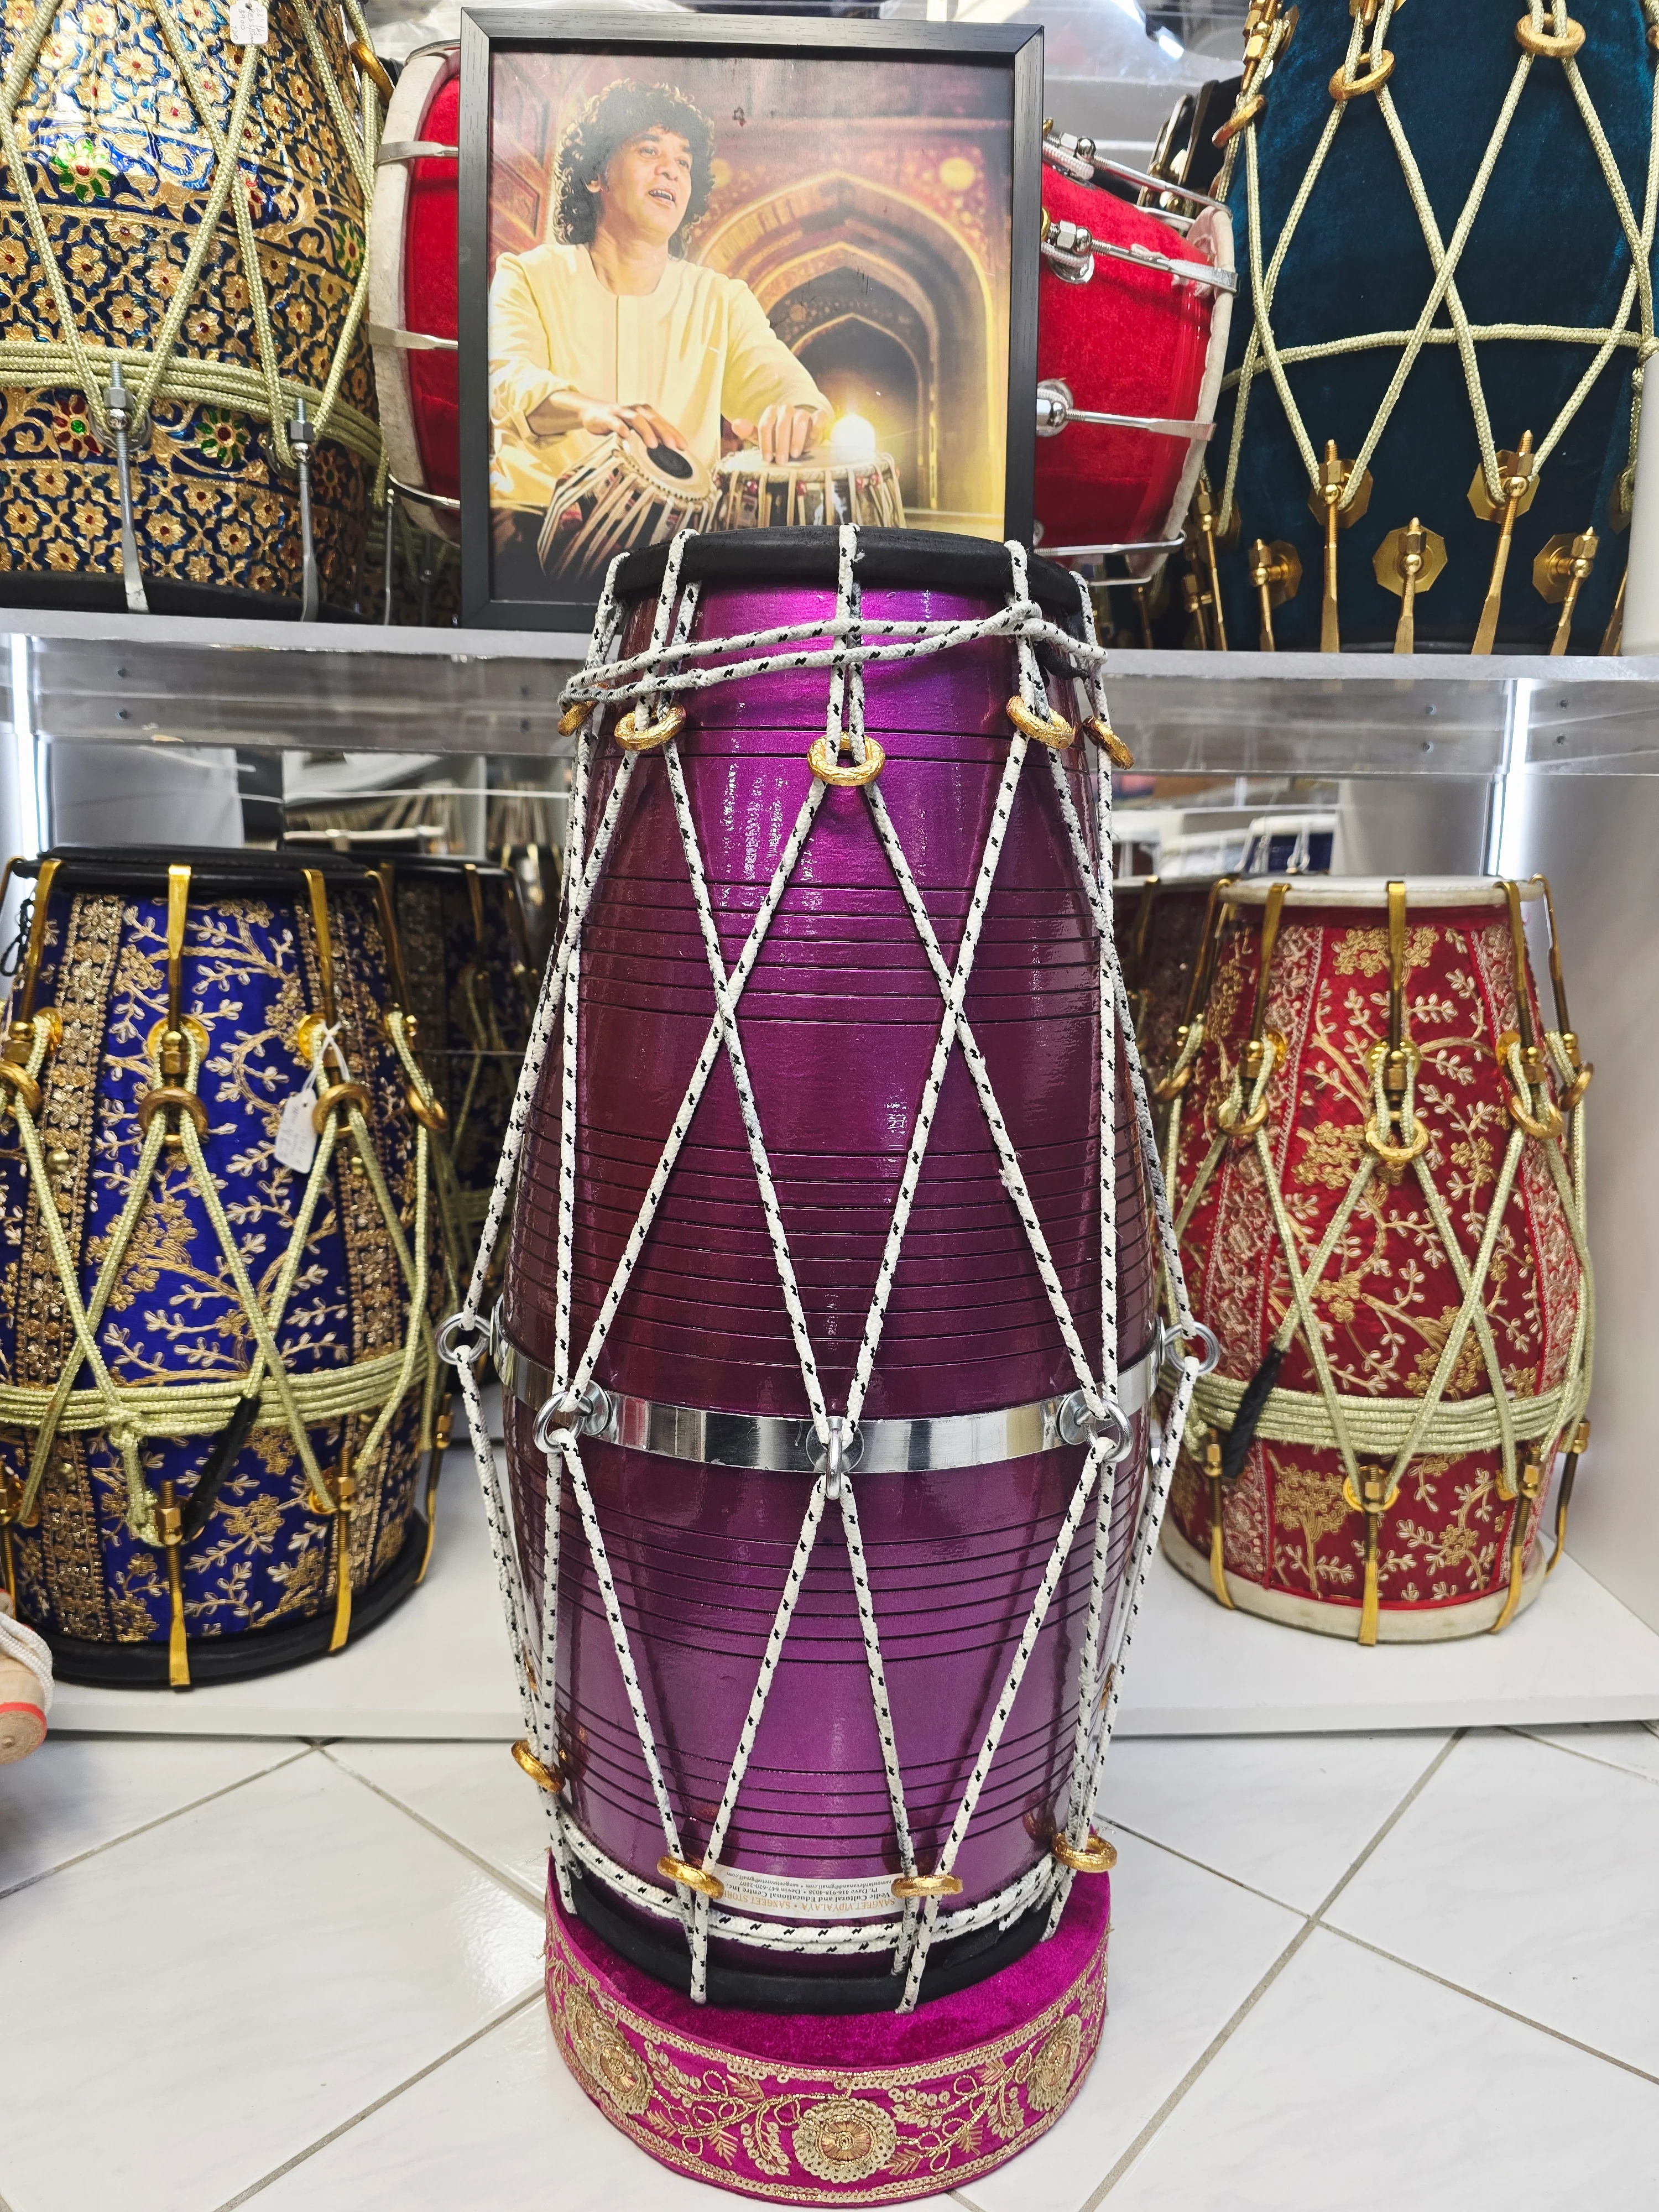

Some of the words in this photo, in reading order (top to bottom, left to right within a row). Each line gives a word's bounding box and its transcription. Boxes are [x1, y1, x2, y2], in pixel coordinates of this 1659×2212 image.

[726, 1872, 799, 1887] sangeetstoreto@gmail.com
[726, 1884, 740, 1892] Inc.
[739, 1881, 779, 1891] 647-620-2107
[742, 1887, 767, 1897] Centre
[869, 1892, 890, 1900] Vedic
[749, 1896, 791, 1909] SANGEET
[770, 1893, 816, 1902] Educational
[802, 1903, 853, 1912] VIDYALAYA
[855, 1898, 895, 1910] SANGEET
